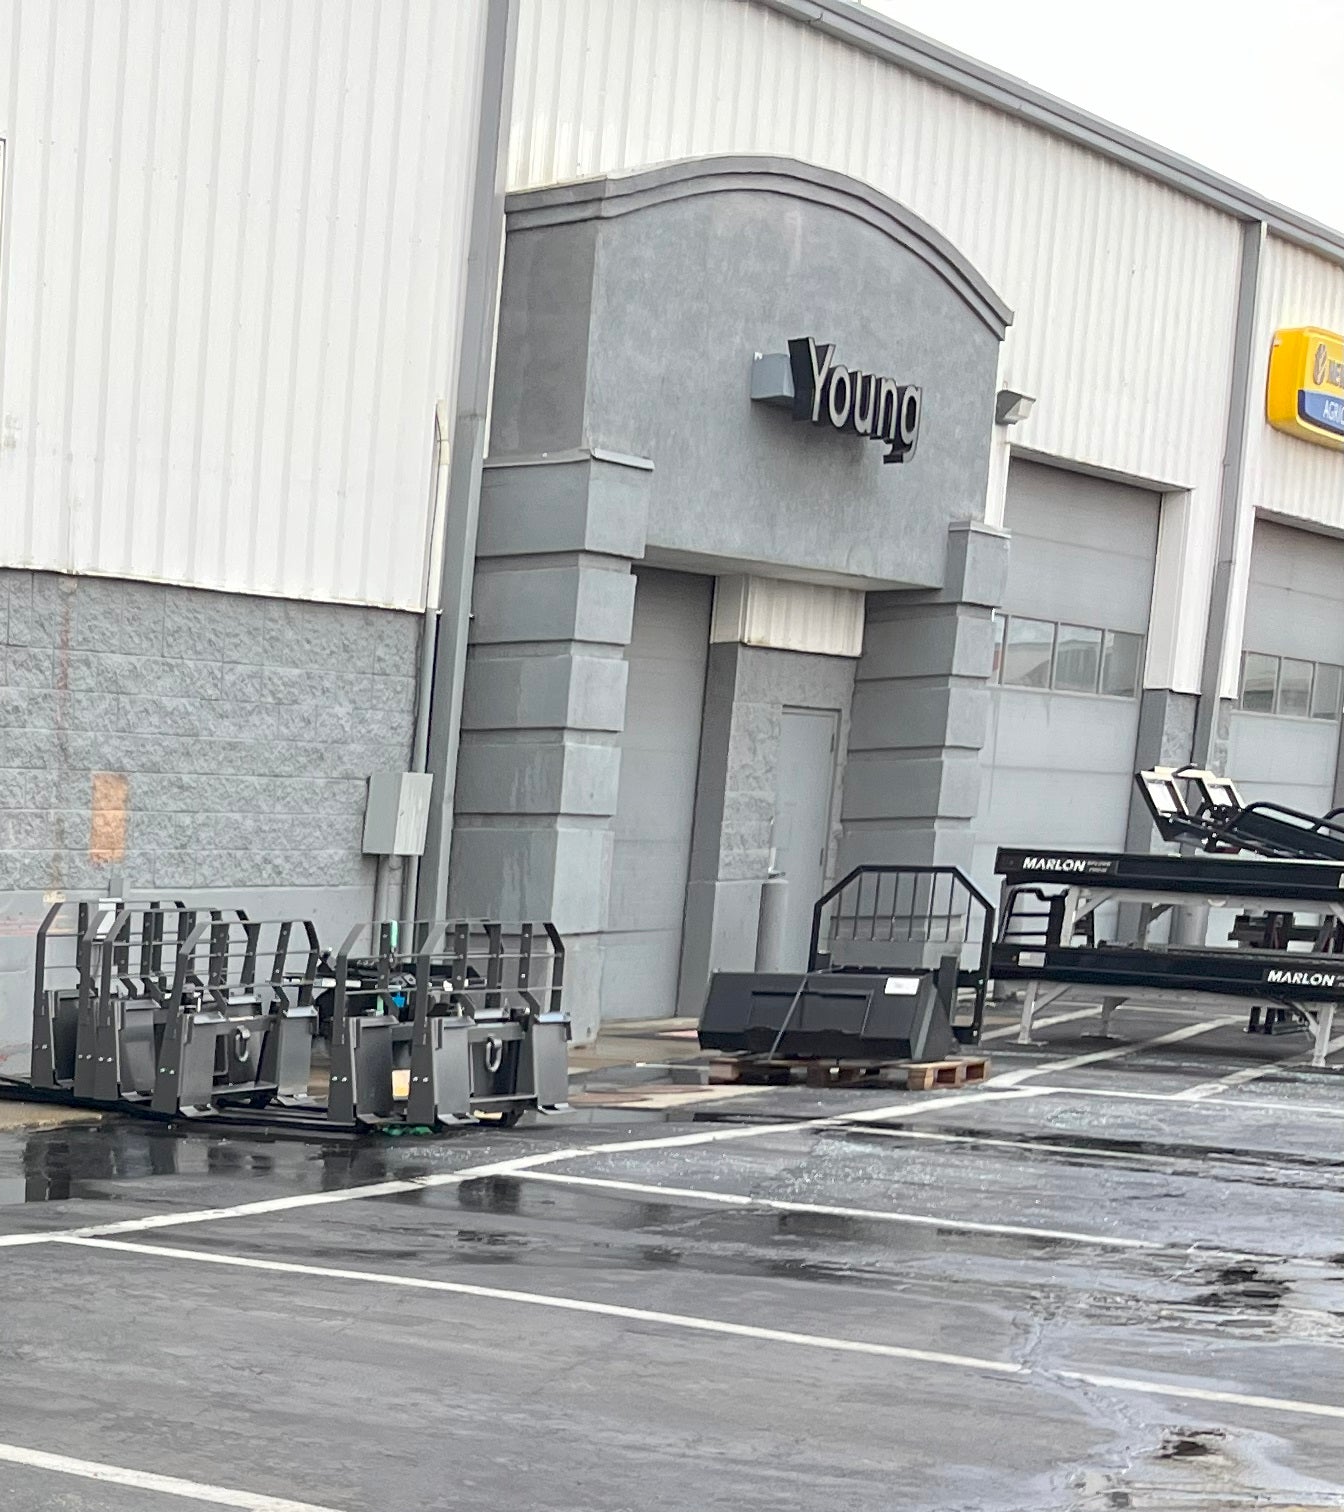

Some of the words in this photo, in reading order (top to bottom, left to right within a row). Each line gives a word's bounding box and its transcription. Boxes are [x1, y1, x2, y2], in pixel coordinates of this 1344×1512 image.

[790, 336, 922, 464] Young
[1023, 856, 1086, 872] MARLON
[1267, 969, 1336, 987] MARLON
